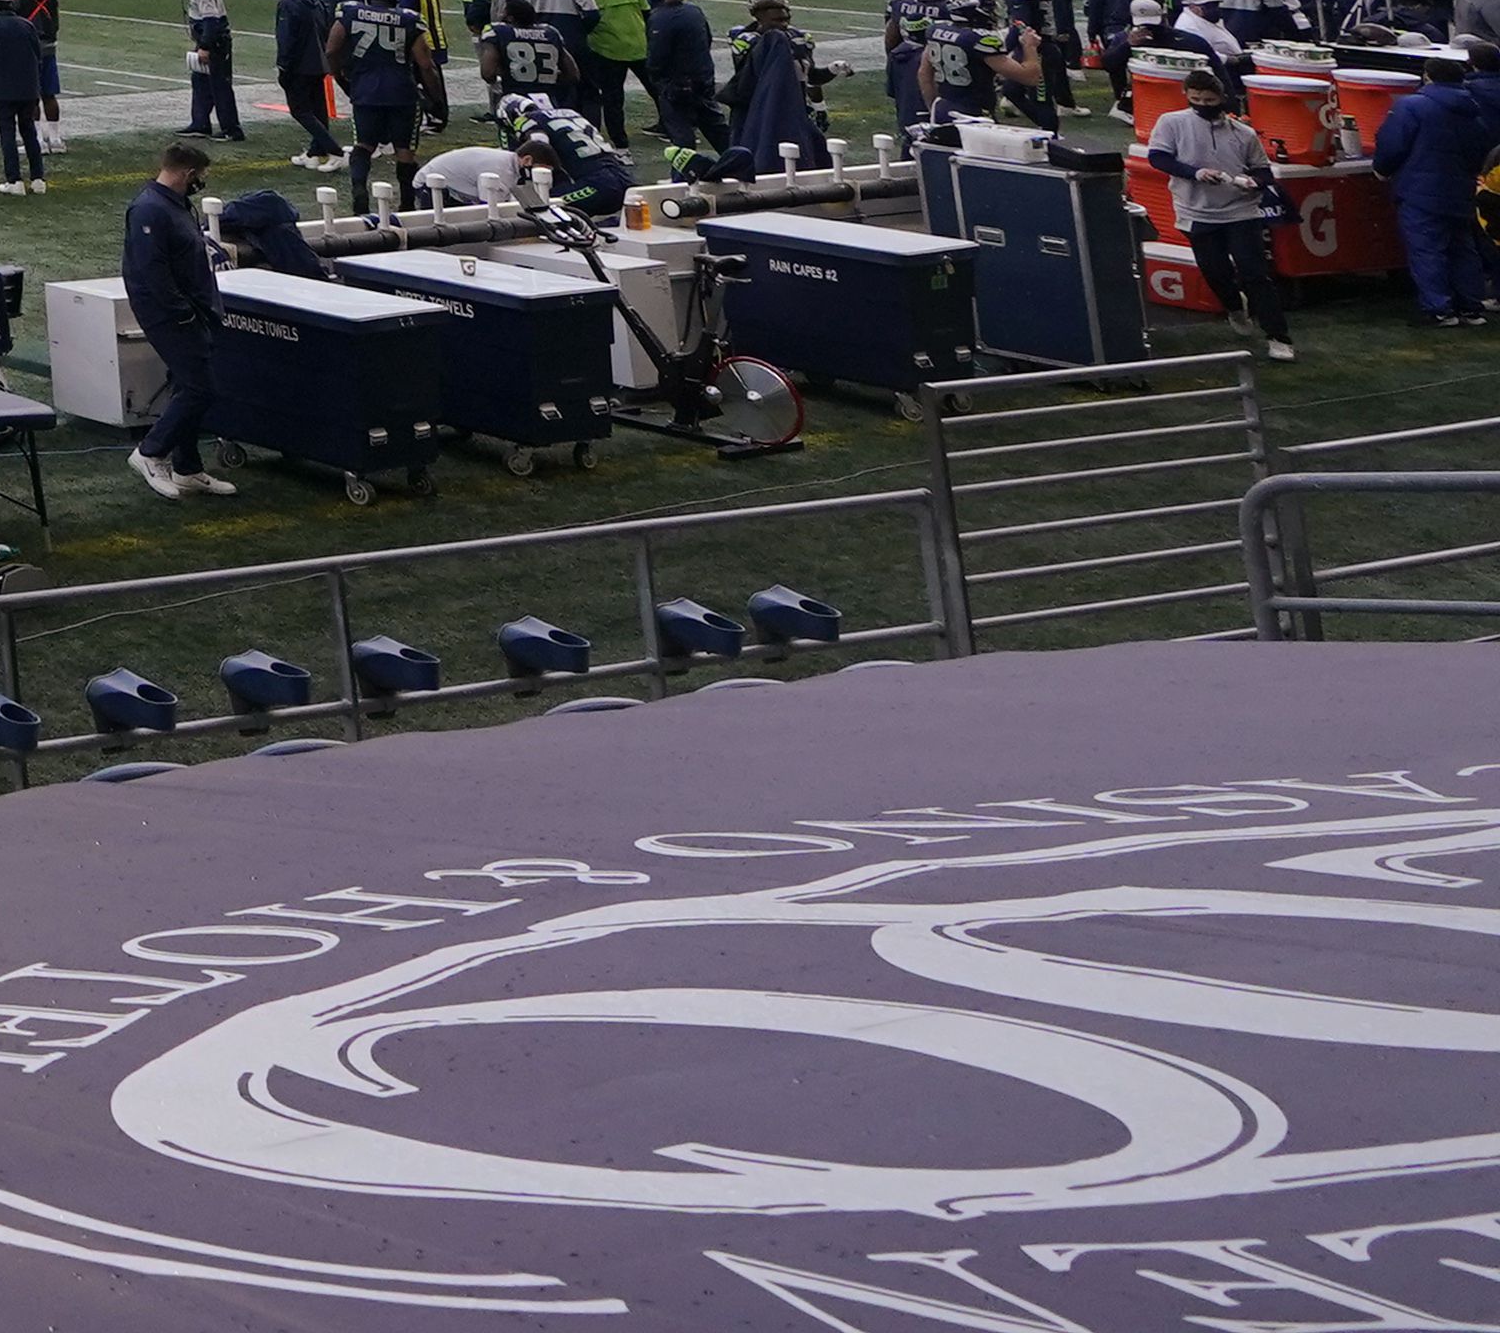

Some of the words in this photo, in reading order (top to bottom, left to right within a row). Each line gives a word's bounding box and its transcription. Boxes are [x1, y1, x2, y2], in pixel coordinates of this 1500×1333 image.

[900, 2, 940, 17] FULLER
[352, 23, 406, 64] 74
[508, 42, 558, 85] 83
[1300, 189, 1338, 258] G
[768, 258, 791, 273] RAIN
[793, 262, 824, 280] CAPES
[825, 268, 839, 282] #2
[1151, 269, 1185, 301] G
[222, 313, 264, 334] GATORADE
[263, 322, 299, 342] TOWELS
